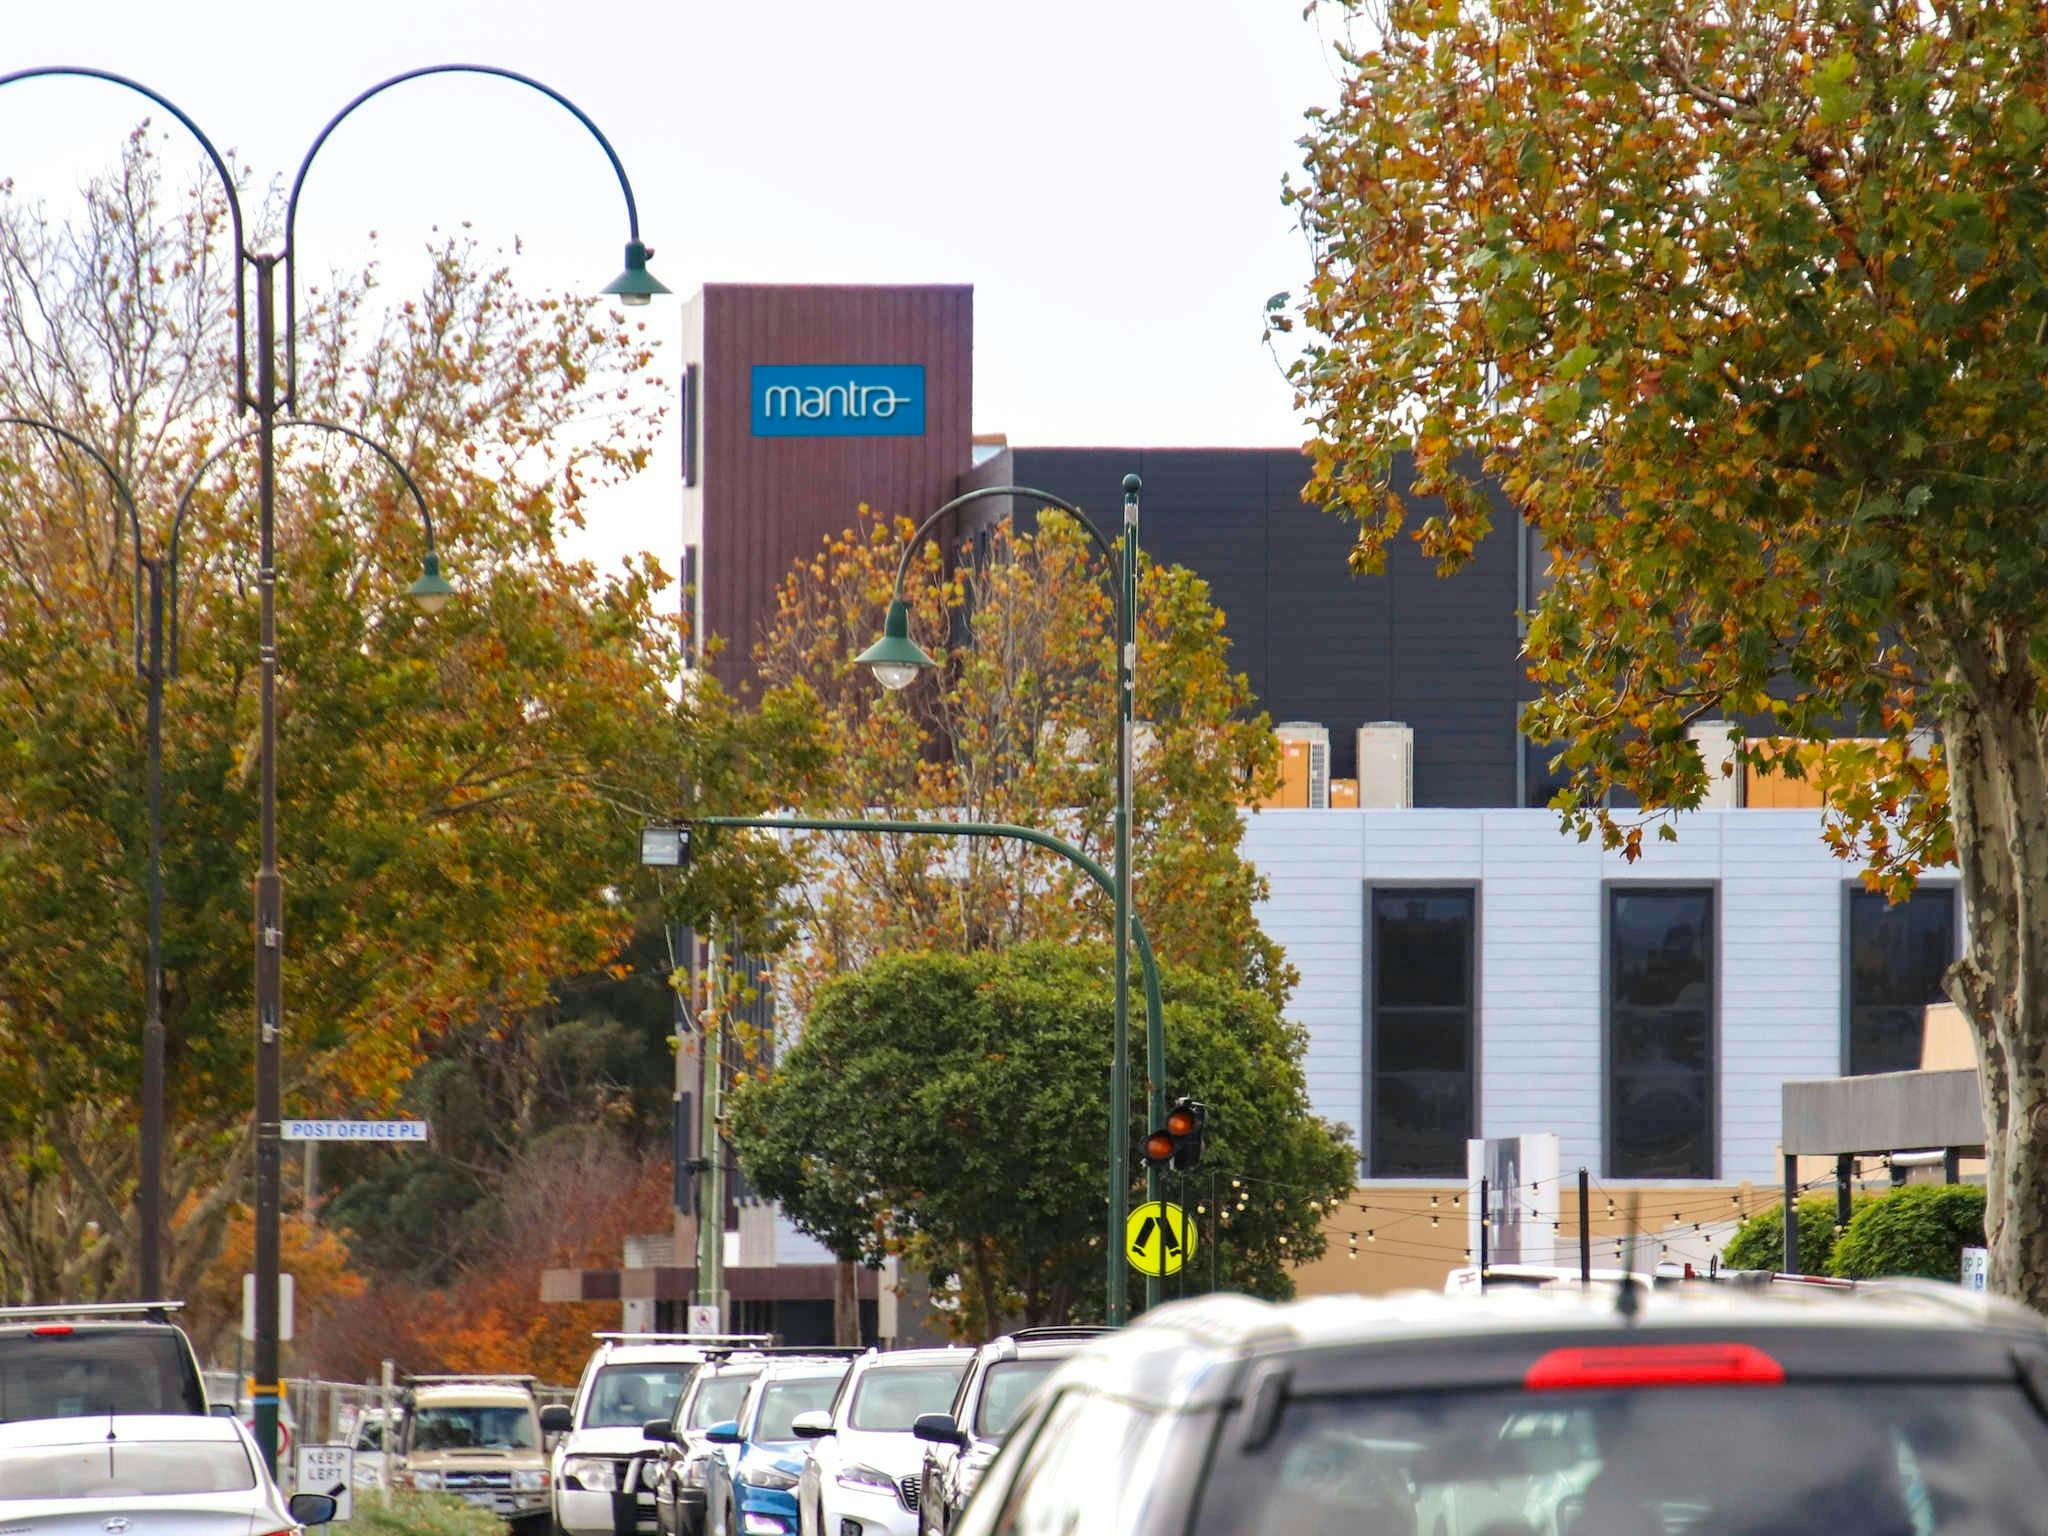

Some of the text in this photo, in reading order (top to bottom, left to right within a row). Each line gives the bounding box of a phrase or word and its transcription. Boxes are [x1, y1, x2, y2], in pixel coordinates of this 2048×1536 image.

[765, 380, 911, 417] mantra
[292, 1123, 420, 1137] POST OFFICE PL
[308, 1452, 344, 1464] KEEP
[308, 1468, 342, 1480] LEFT
